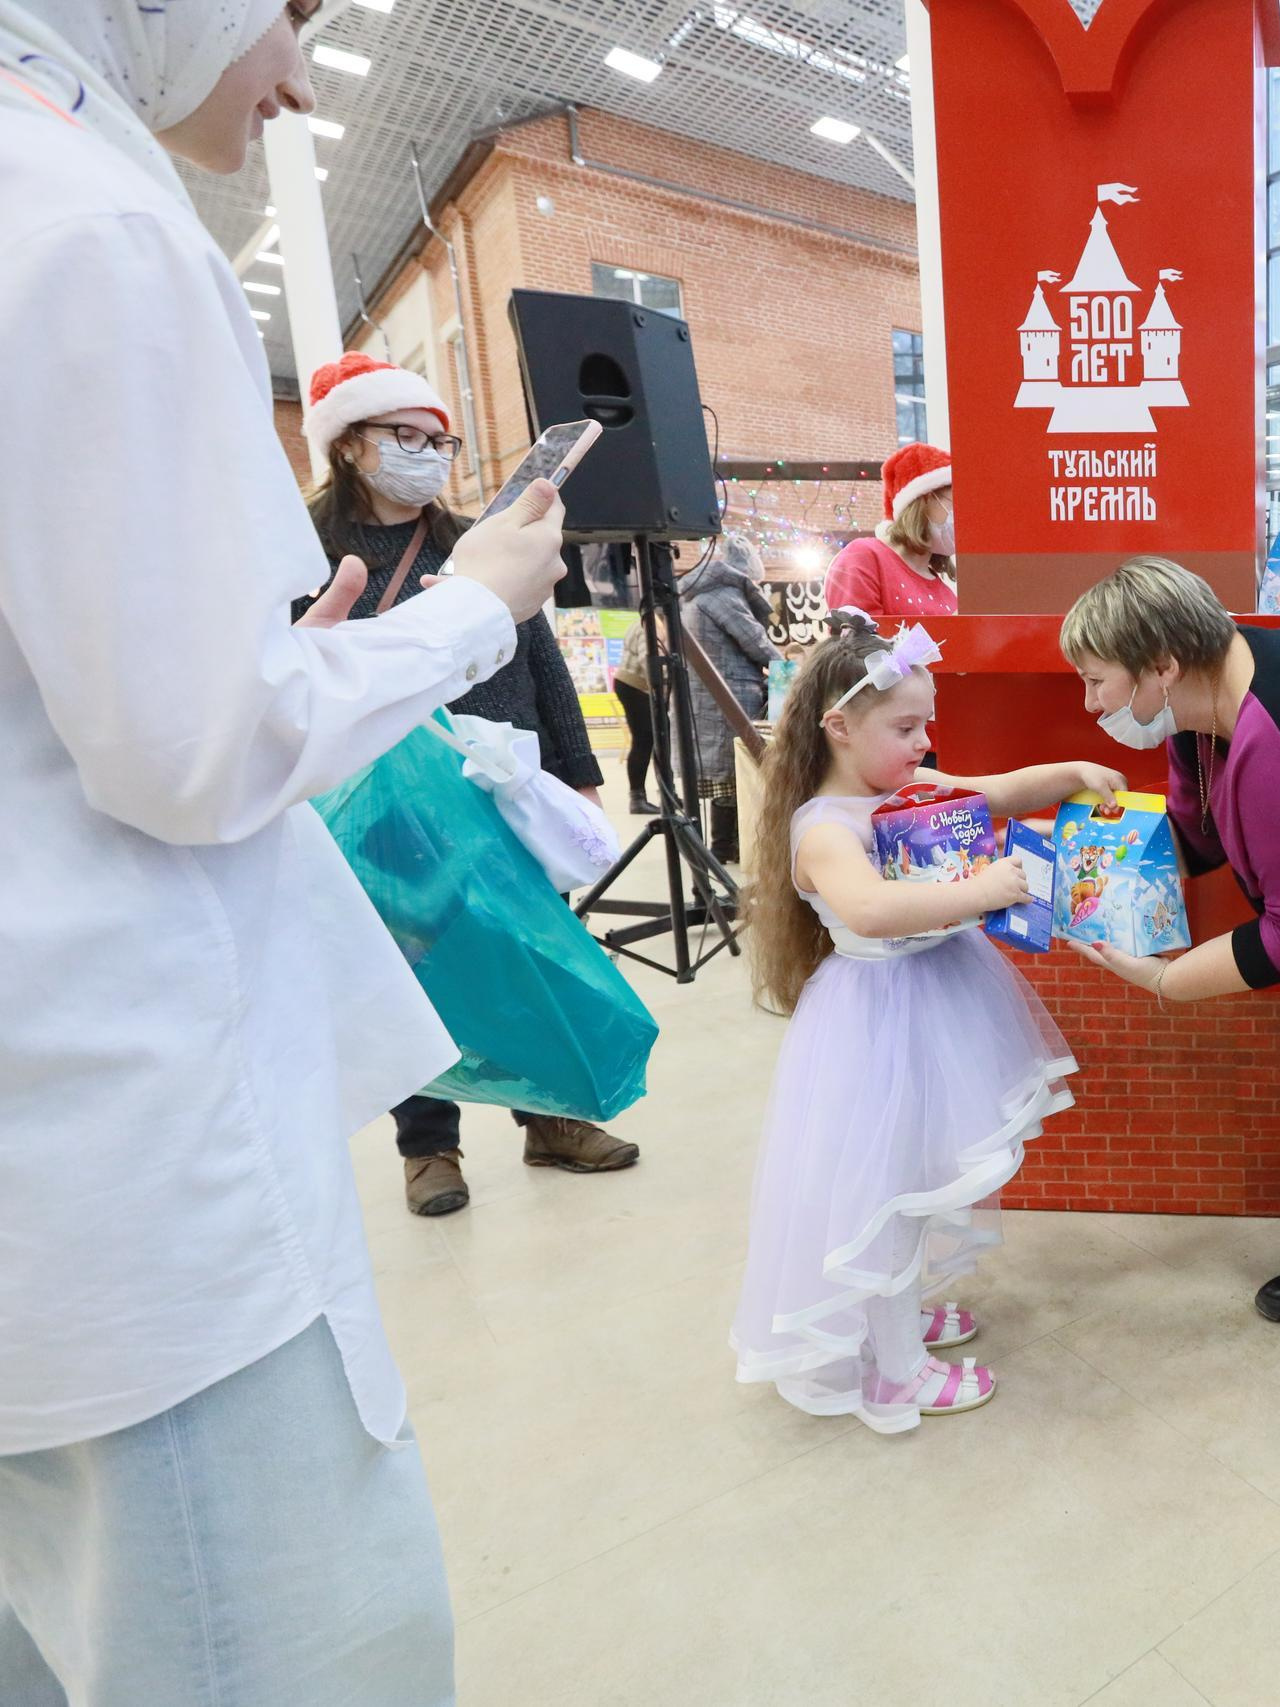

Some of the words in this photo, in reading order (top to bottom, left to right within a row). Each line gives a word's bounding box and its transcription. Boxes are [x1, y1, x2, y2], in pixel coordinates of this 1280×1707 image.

[1069, 295, 1133, 340] 500
[1070, 343, 1133, 382] ЛЕТ
[1048, 443, 1157, 478] ТУЛЬСКИЙ
[1049, 486, 1157, 521] КРЕМЛЬ
[930, 814, 940, 830] С
